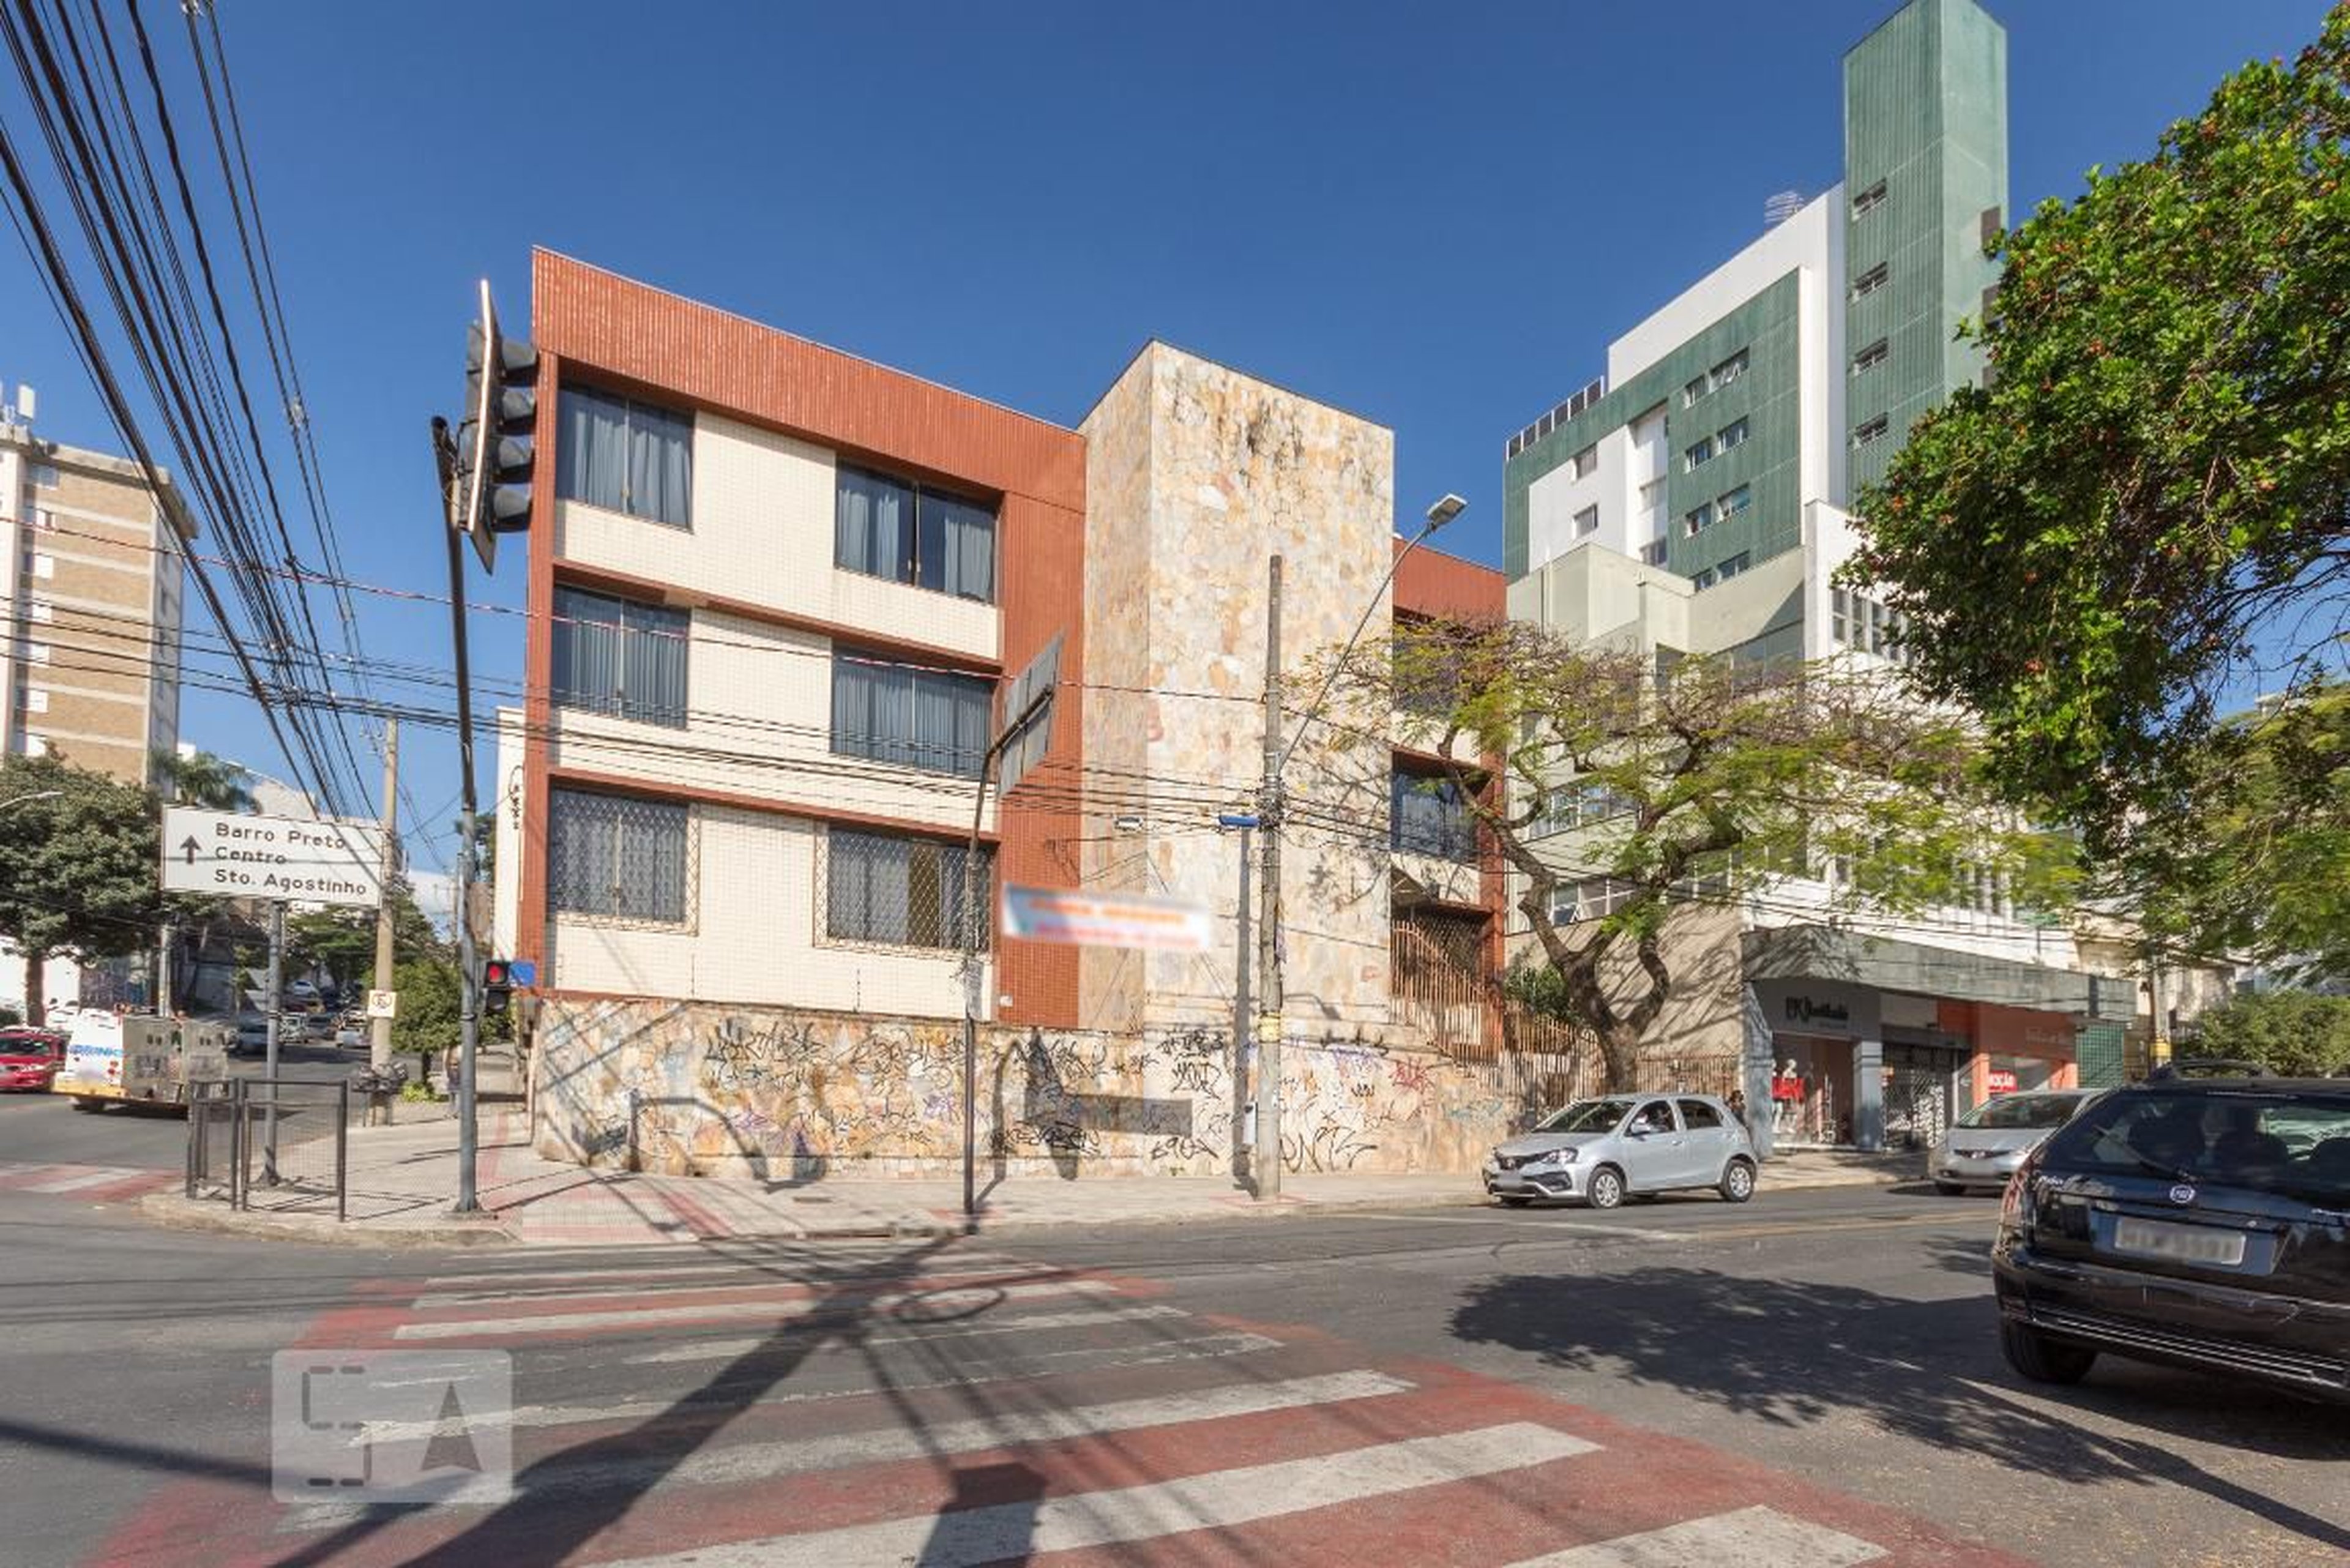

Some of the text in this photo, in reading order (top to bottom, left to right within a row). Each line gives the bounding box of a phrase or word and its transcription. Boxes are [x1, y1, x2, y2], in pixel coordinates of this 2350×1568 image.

[216, 823, 346, 849] Barro Preto
[215, 846, 287, 864] Centro
[215, 869, 367, 895] Sto. Agostinho
